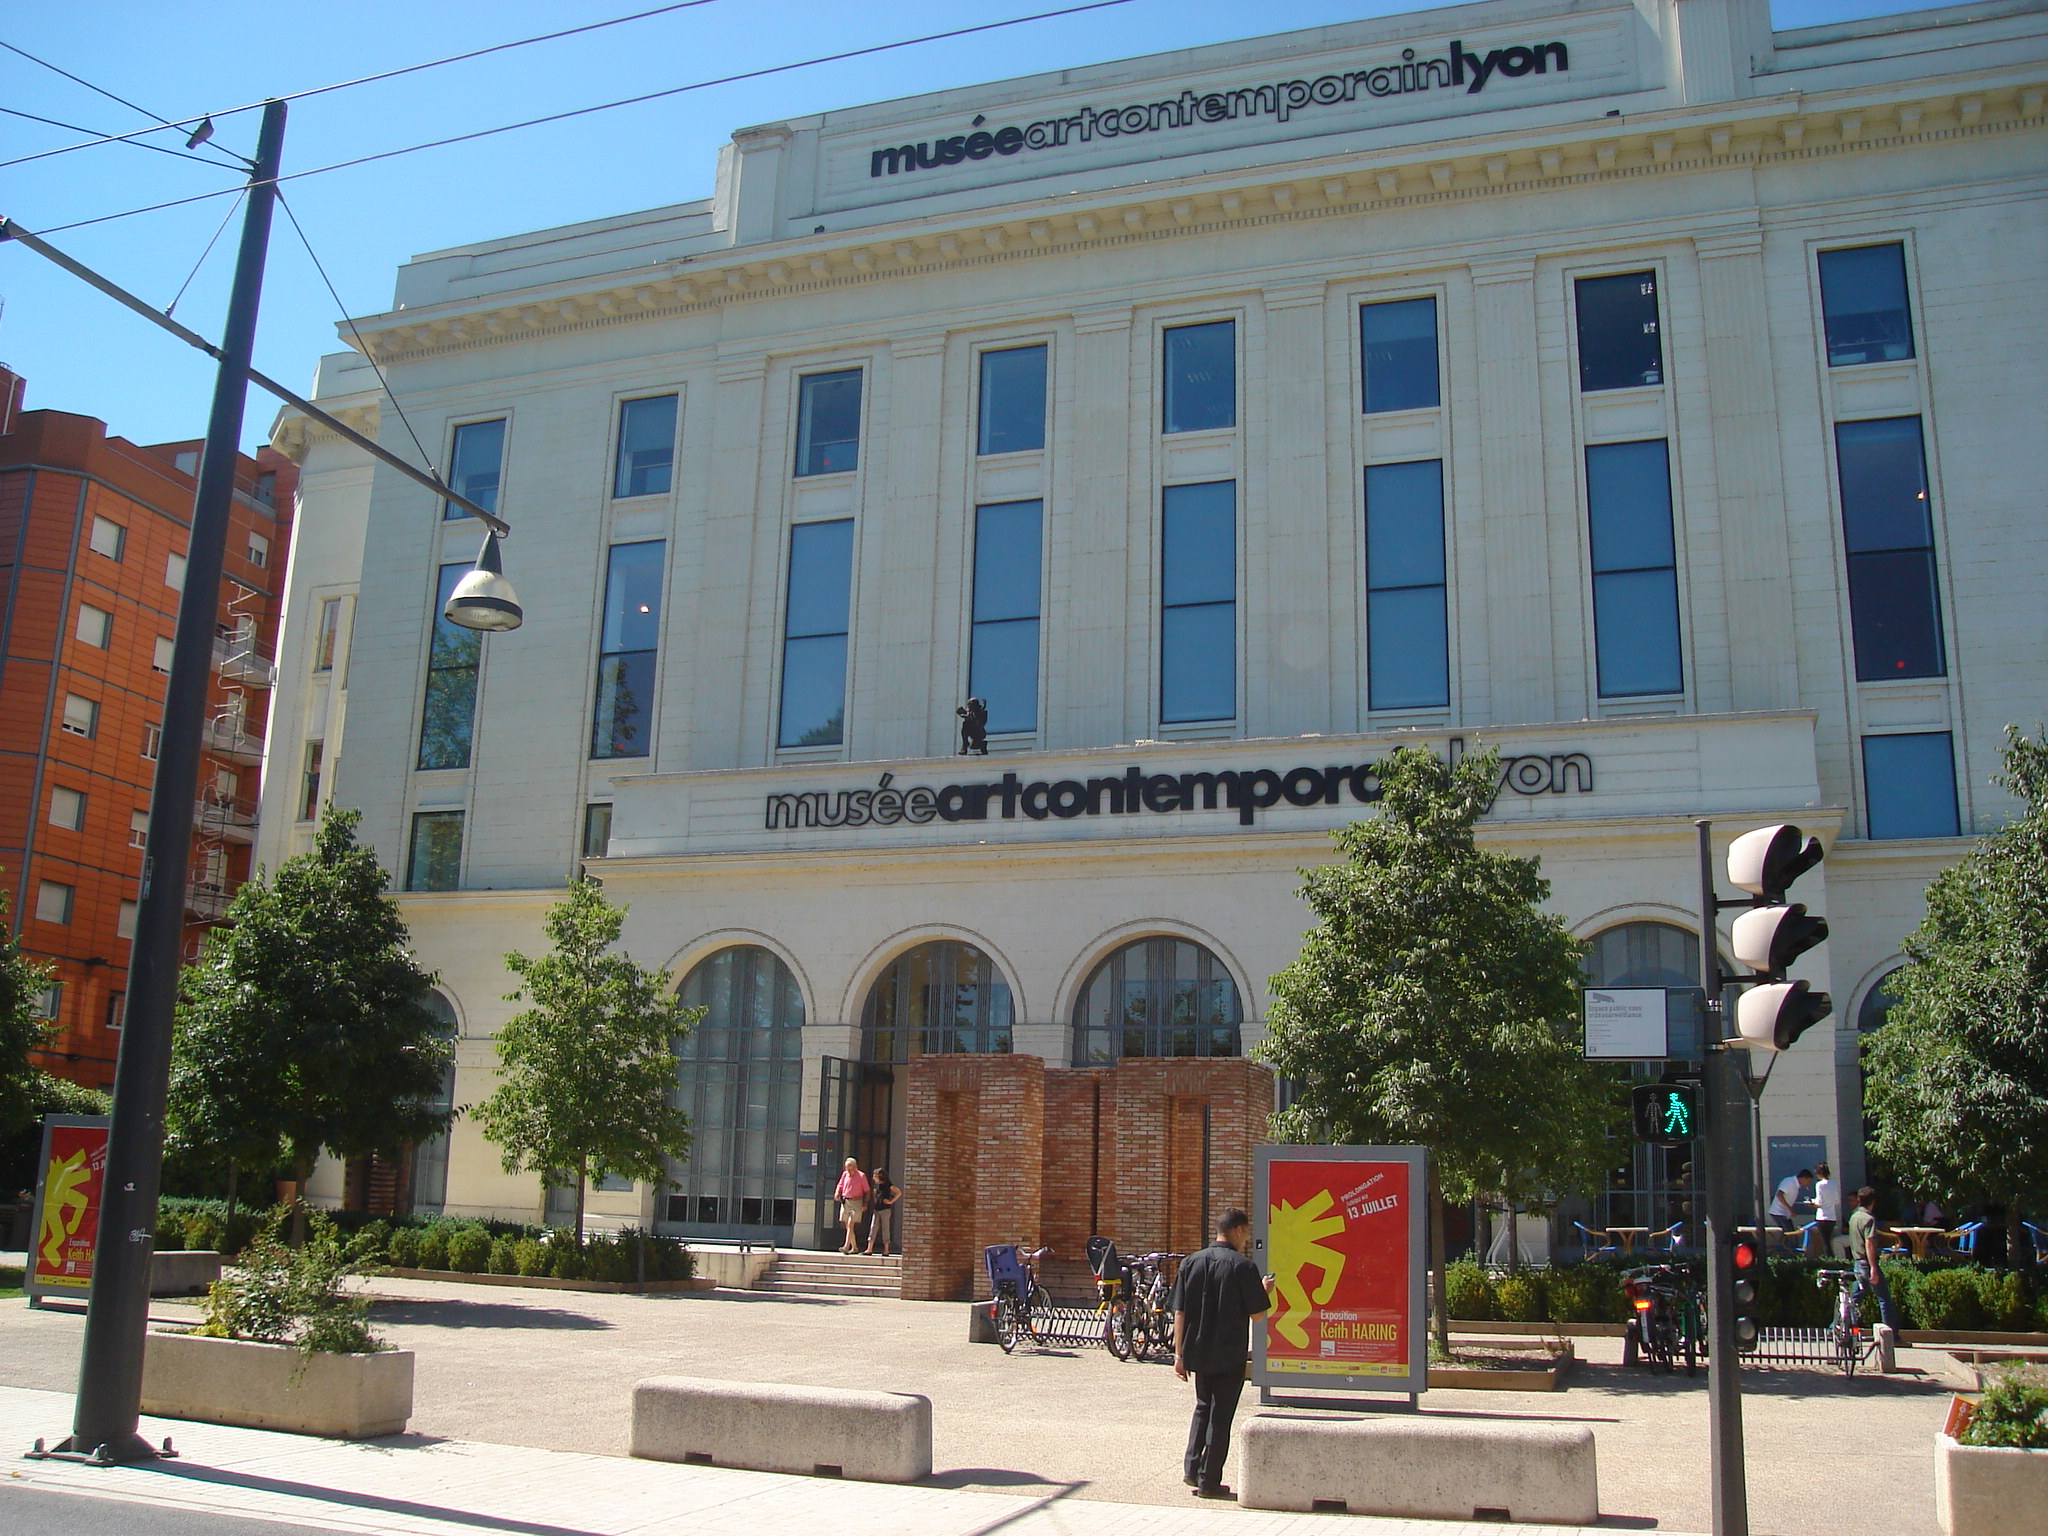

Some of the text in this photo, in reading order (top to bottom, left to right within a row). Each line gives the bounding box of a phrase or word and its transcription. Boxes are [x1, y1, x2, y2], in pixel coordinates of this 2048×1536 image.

[1340, 1172, 1384, 1202] PROLONGATION
[1347, 1194, 1399, 1219] 13 JUILLET
[1320, 1309, 1358, 1323] Exposition
[1320, 1321, 1398, 1341] Keith HARING
